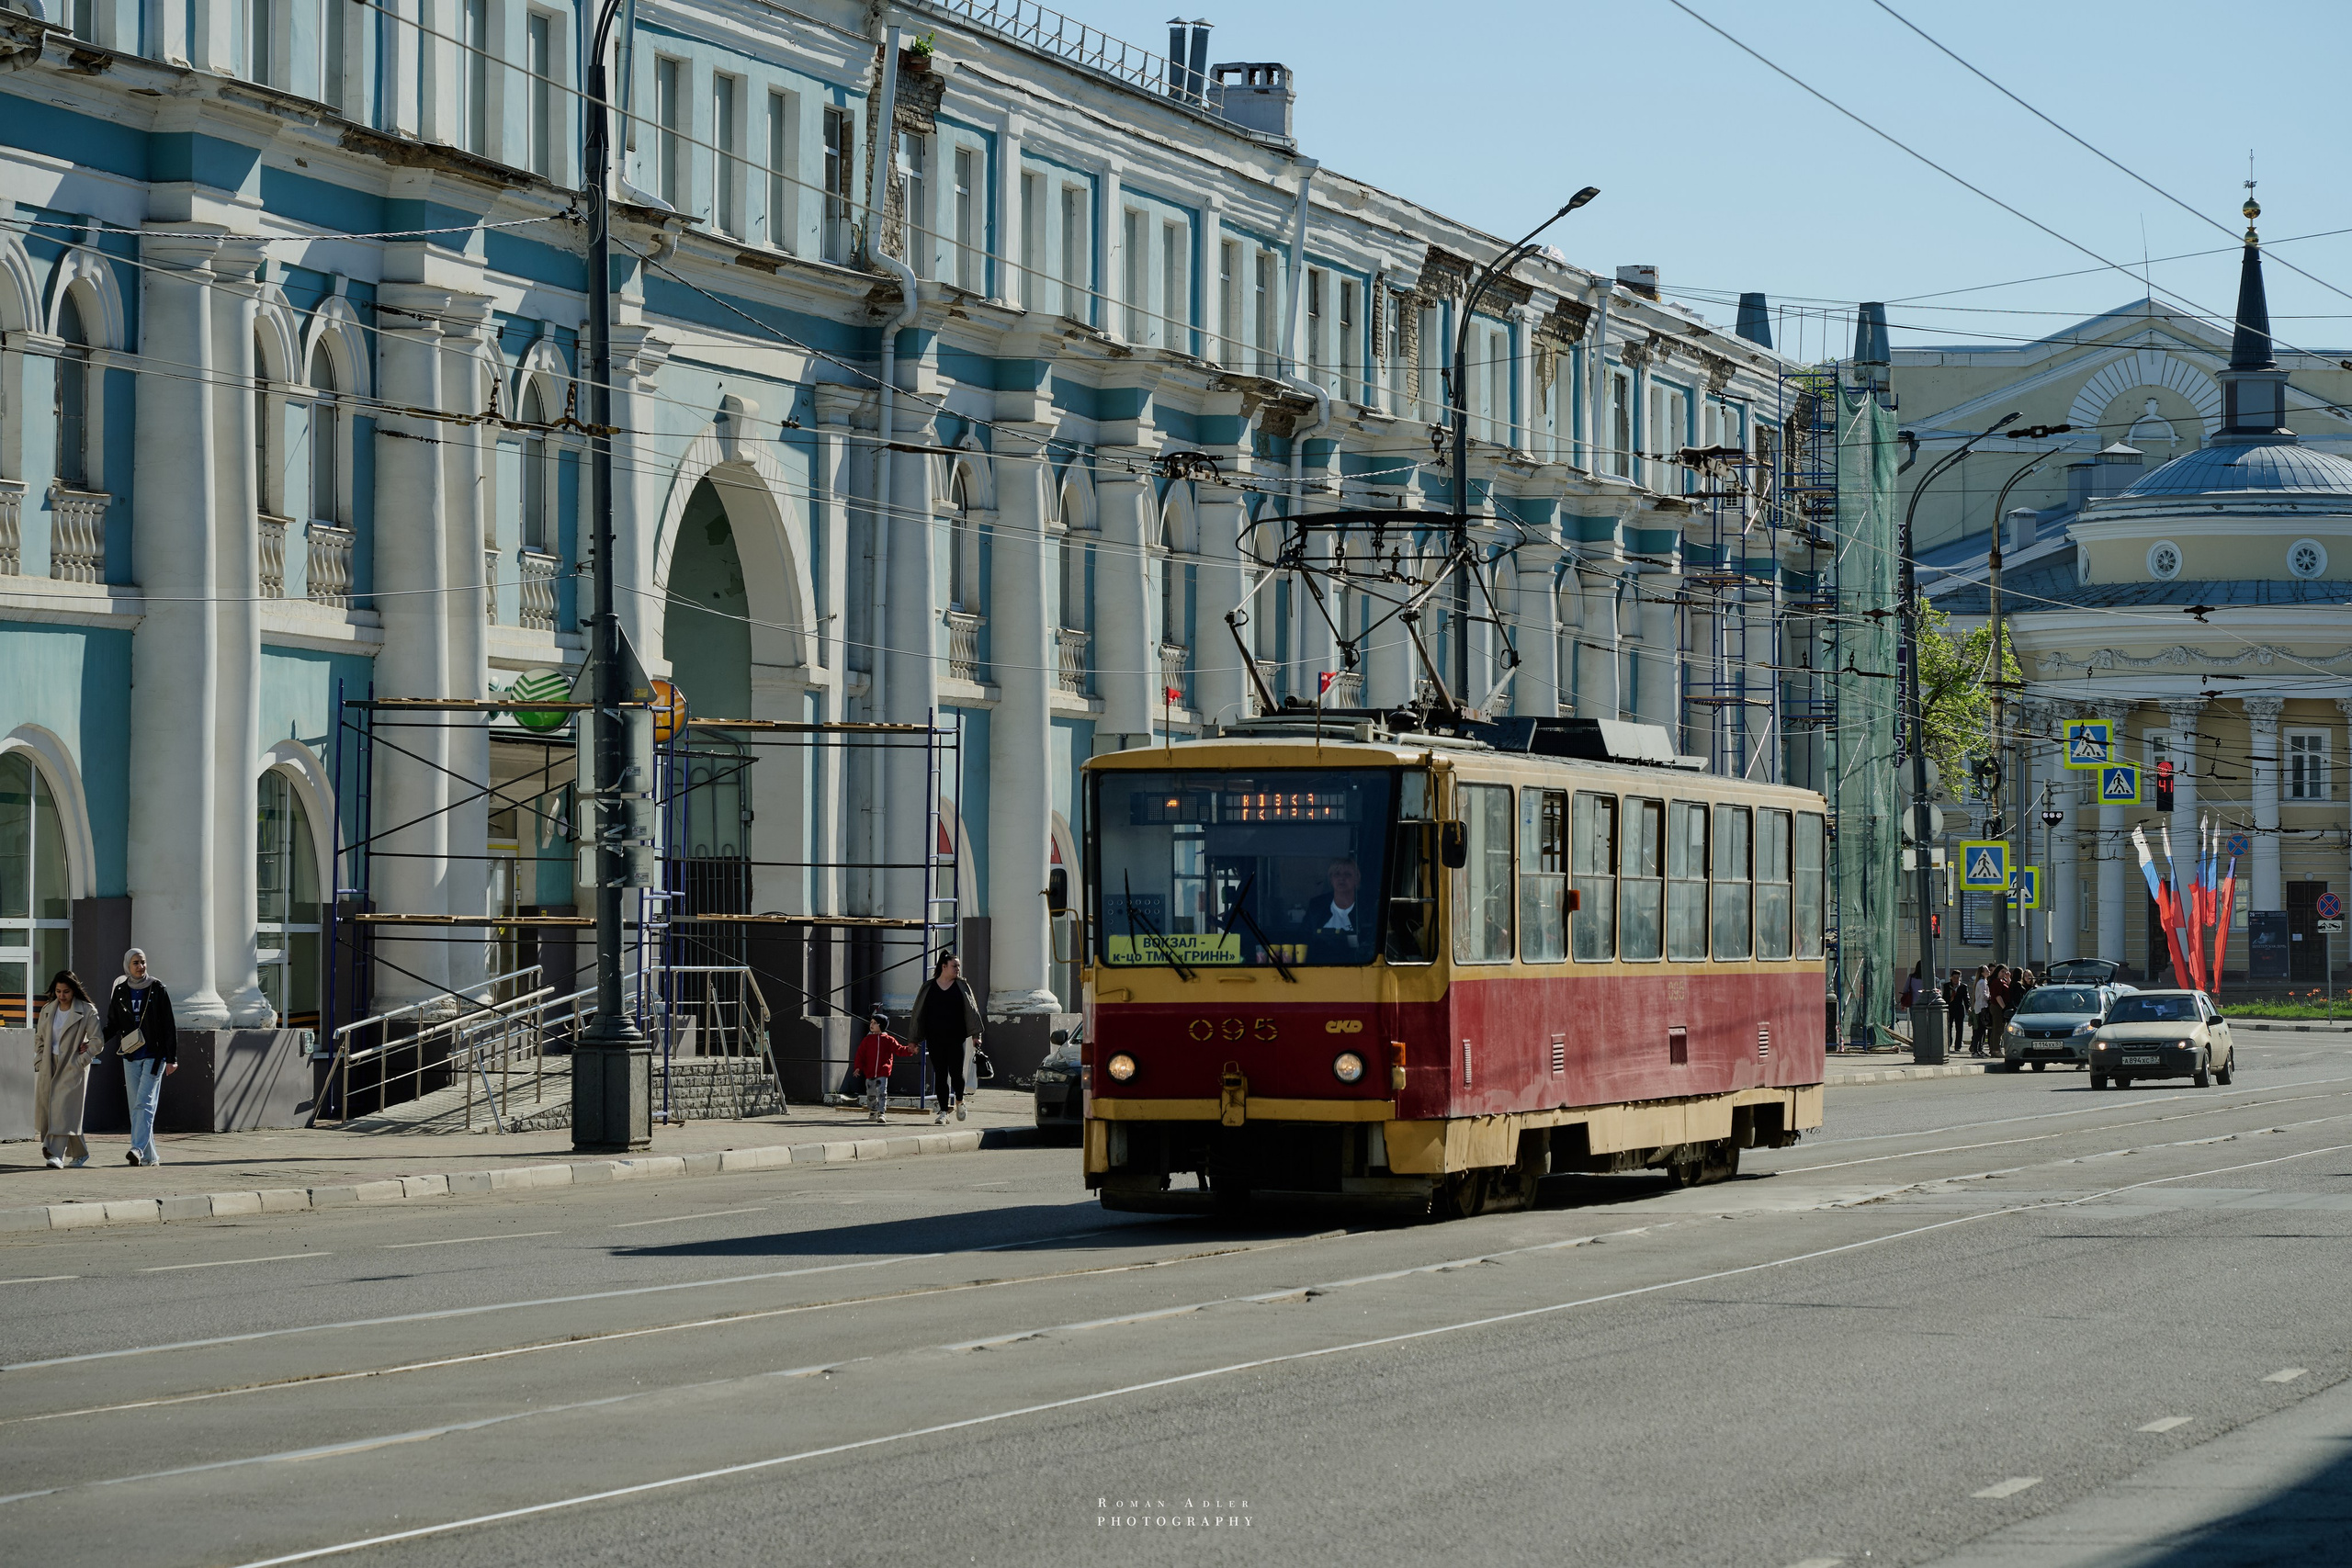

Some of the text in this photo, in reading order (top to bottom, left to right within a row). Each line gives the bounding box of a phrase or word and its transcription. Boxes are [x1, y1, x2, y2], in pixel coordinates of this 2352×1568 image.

[2158, 779, 2174, 794] 41
[1143, 937, 1197, 948] ВОКЗАЛ
[1113, 950, 1236, 964] к-цо ТМК «ГРИНН»
[1188, 1018, 1278, 1042] 095
